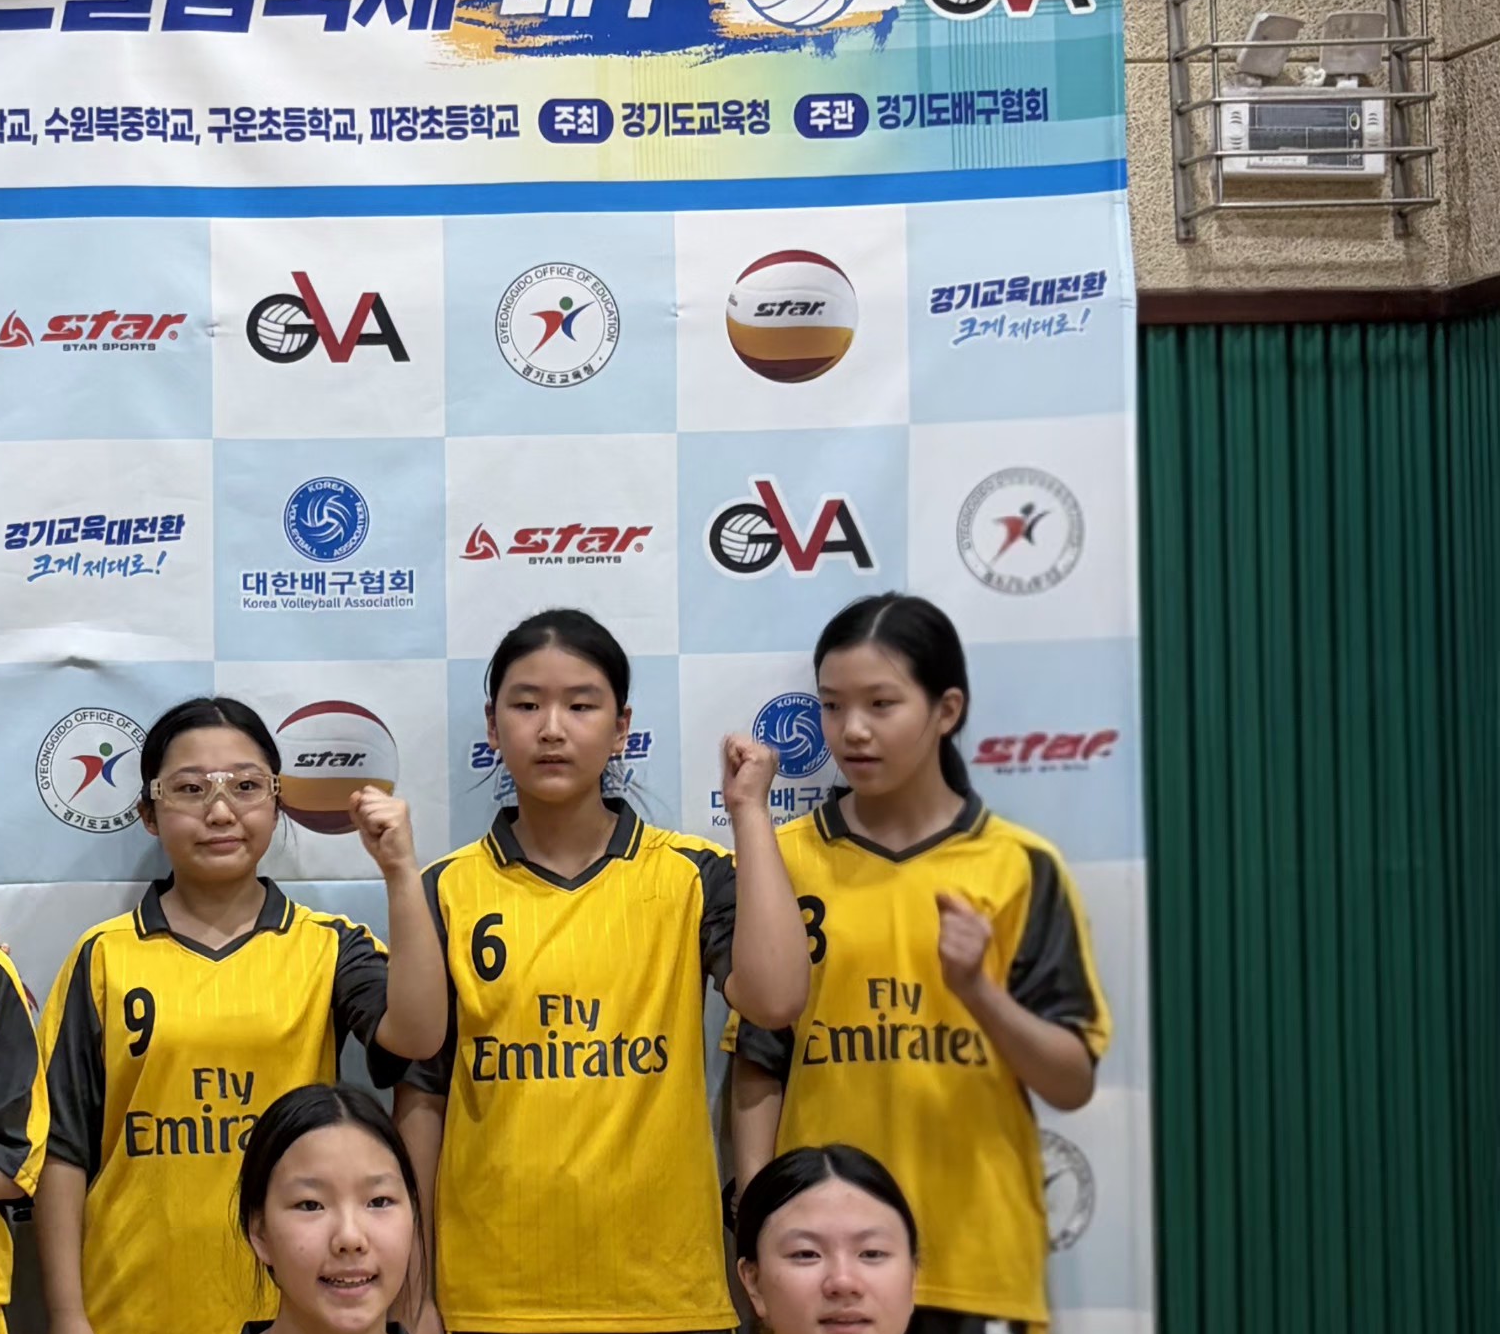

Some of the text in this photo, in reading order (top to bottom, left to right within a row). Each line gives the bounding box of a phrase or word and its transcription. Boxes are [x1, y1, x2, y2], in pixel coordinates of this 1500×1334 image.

[44, 106, 202, 147] 수원북중학교,
[207, 105, 364, 147] 구운초등학교,
[369, 104, 520, 142] 파장초등학교
[553, 105, 600, 137] 주최
[621, 99, 772, 138] 경기도교육청
[808, 101, 856, 132] 주관
[876, 88, 1050, 131] 경기도배구협회
[500, 266, 618, 344] GYEONGGIDO OFFICE OF EDUCATION
[753, 299, 826, 317] star
[930, 270, 1106, 314] 경기교육대전환
[40, 309, 187, 343] star
[246, 271, 410, 363] GVA
[952, 309, 1091, 345] 크게 제대로!
[63, 342, 156, 352] STAR SPORTS
[307, 482, 345, 494] KOREA
[4, 514, 186, 550] 경기교육대전환
[506, 522, 653, 554] star
[709, 480, 874, 573] GVA
[27, 551, 167, 584] 크게 제대로!
[528, 555, 622, 565] STAR SPORTS
[242, 570, 414, 596] 대한배구협회
[243, 596, 413, 610] Korea Volleyball Association
[74, 711, 115, 723] OFFICE
[116, 717, 132, 730] OF
[294, 750, 367, 768] star
[471, 913, 507, 982] 6
[538, 994, 600, 1032] Fly
[867, 977, 923, 1015] Fly
[123, 987, 156, 1057] 9
[472, 1030, 668, 1082] Emirates
[192, 1067, 254, 1105] Fly
[124, 1103, 260, 1157] Emira
